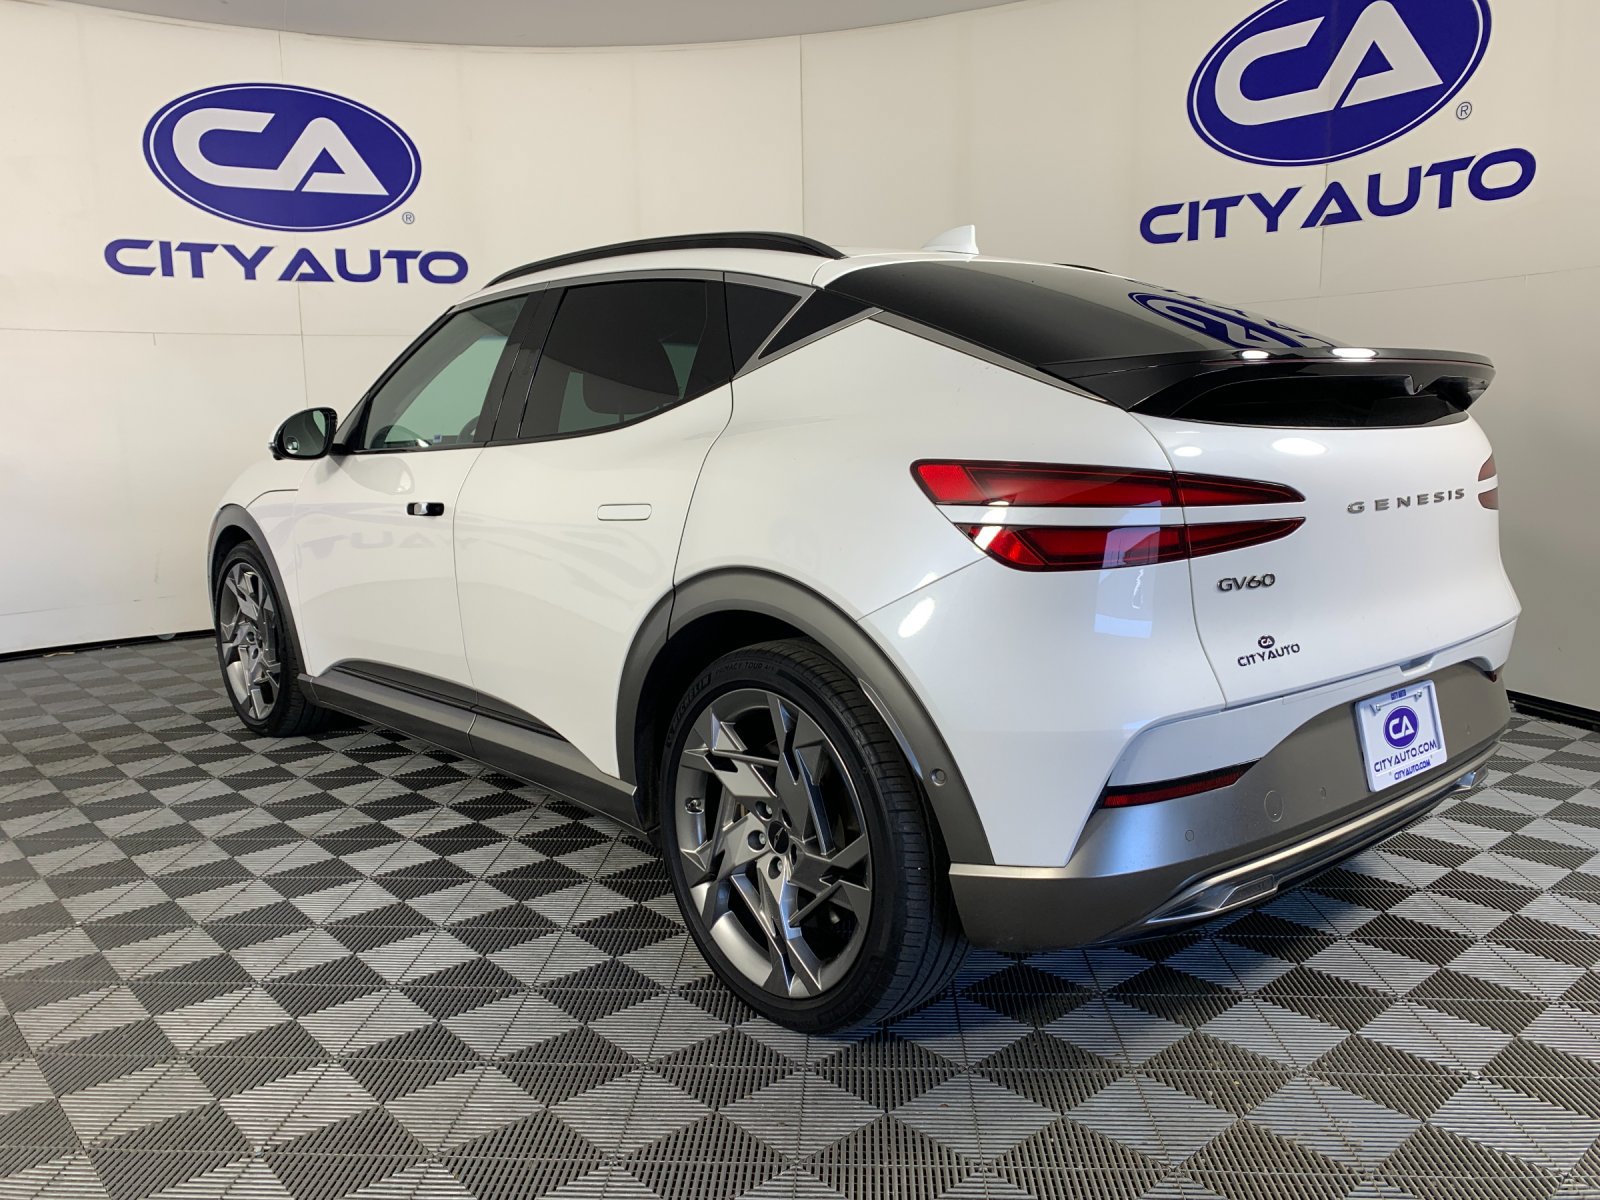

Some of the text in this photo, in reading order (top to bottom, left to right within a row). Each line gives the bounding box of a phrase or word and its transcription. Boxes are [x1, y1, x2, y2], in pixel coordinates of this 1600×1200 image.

[1215, 0, 1444, 126] CA
[172, 107, 390, 196] CA
[1347, 488, 1465, 515] GENESIS
[1216, 573, 1276, 593] GV60
[1388, 715, 1414, 740] CA
[1374, 739, 1437, 772] CITYAUTO.COM
